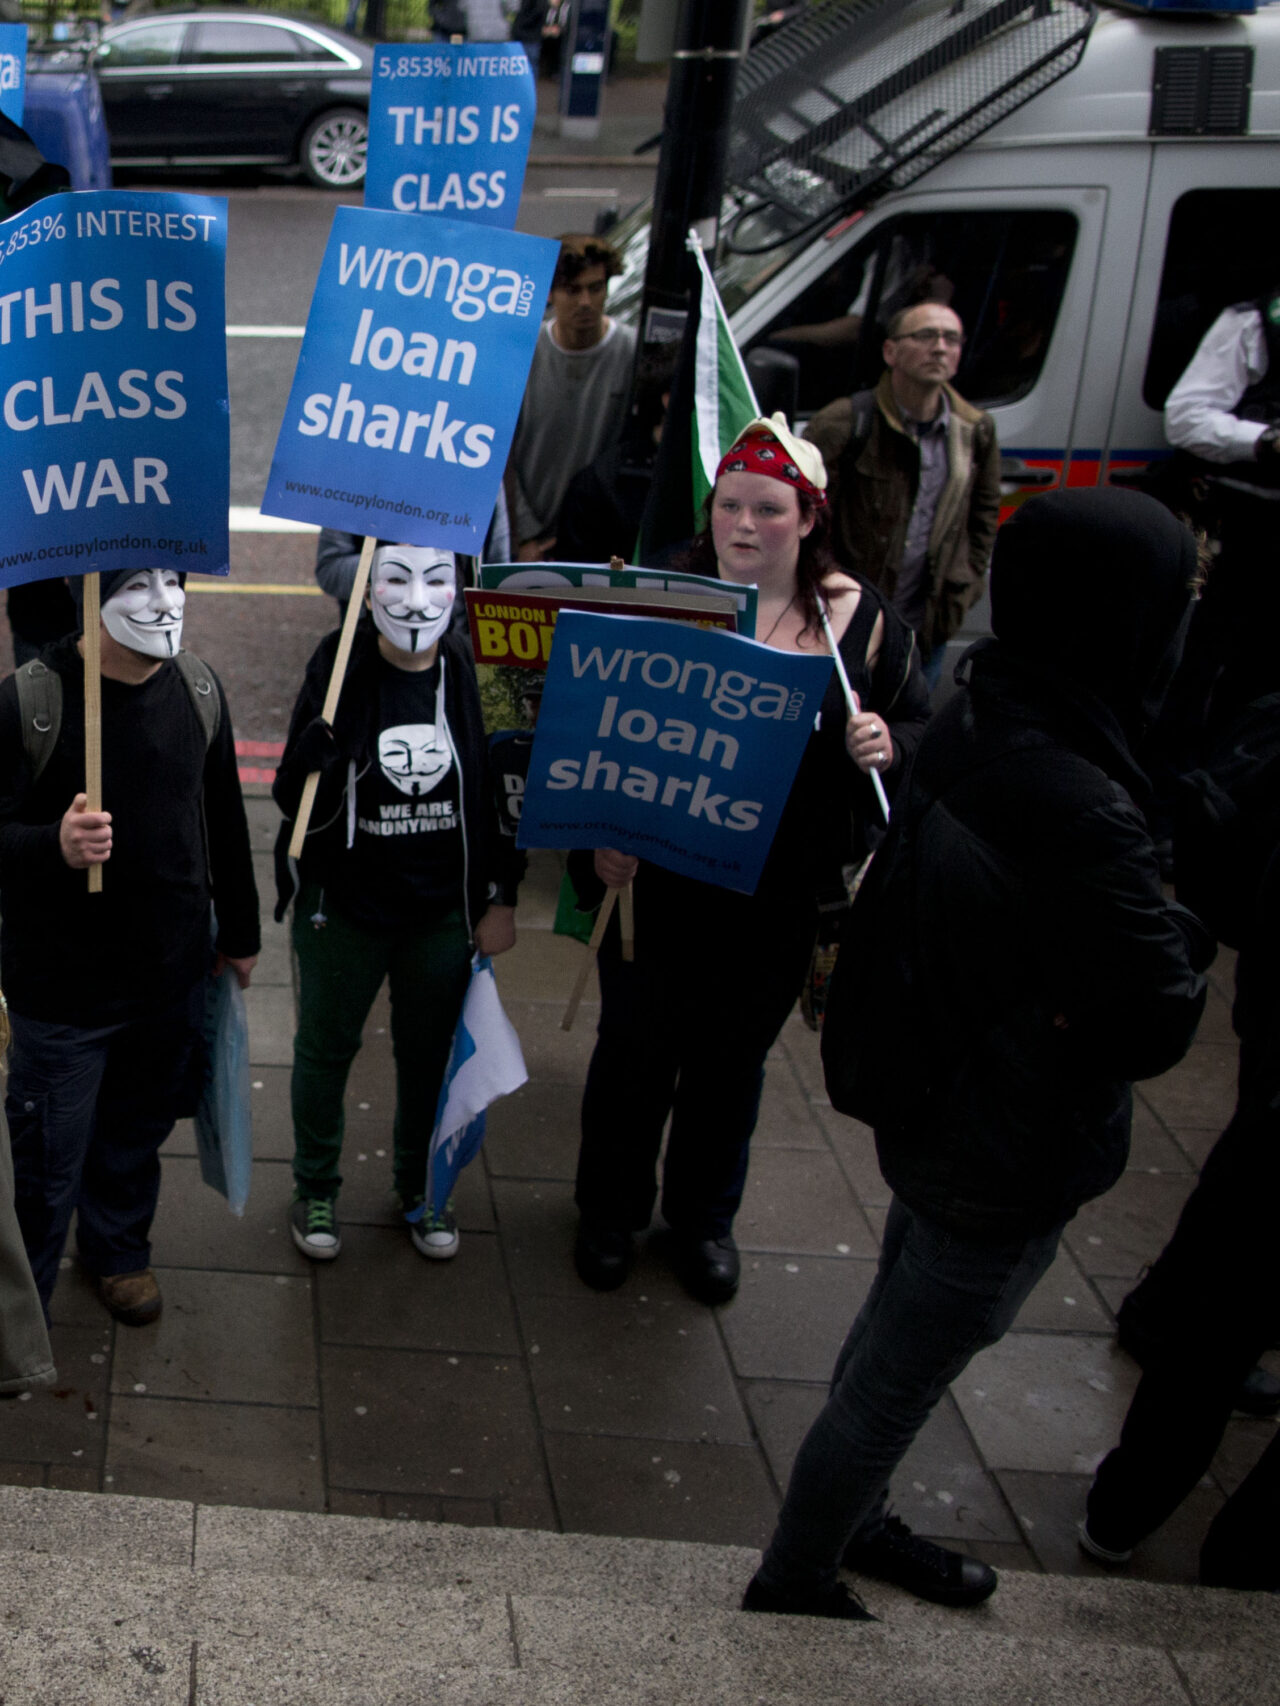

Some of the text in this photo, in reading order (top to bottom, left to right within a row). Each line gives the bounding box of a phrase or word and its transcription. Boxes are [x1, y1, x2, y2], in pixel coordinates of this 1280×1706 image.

[379, 56, 451, 80] 5,853%
[388, 104, 520, 145] THIS IS
[392, 170, 506, 211] CLASS
[77, 210, 216, 242] INTEREST
[146, 279, 197, 332] IS
[350, 308, 477, 386] loan
[3, 369, 187, 431] CLASS
[297, 382, 495, 468] sharks
[22, 457, 171, 515] WAR
[285, 479, 472, 527] www.occupylondon.org.uk
[473, 603, 547, 624] LONDON
[597, 696, 740, 770] loan
[379, 800, 453, 820] WE ARE
[546, 750, 764, 832] sharks
